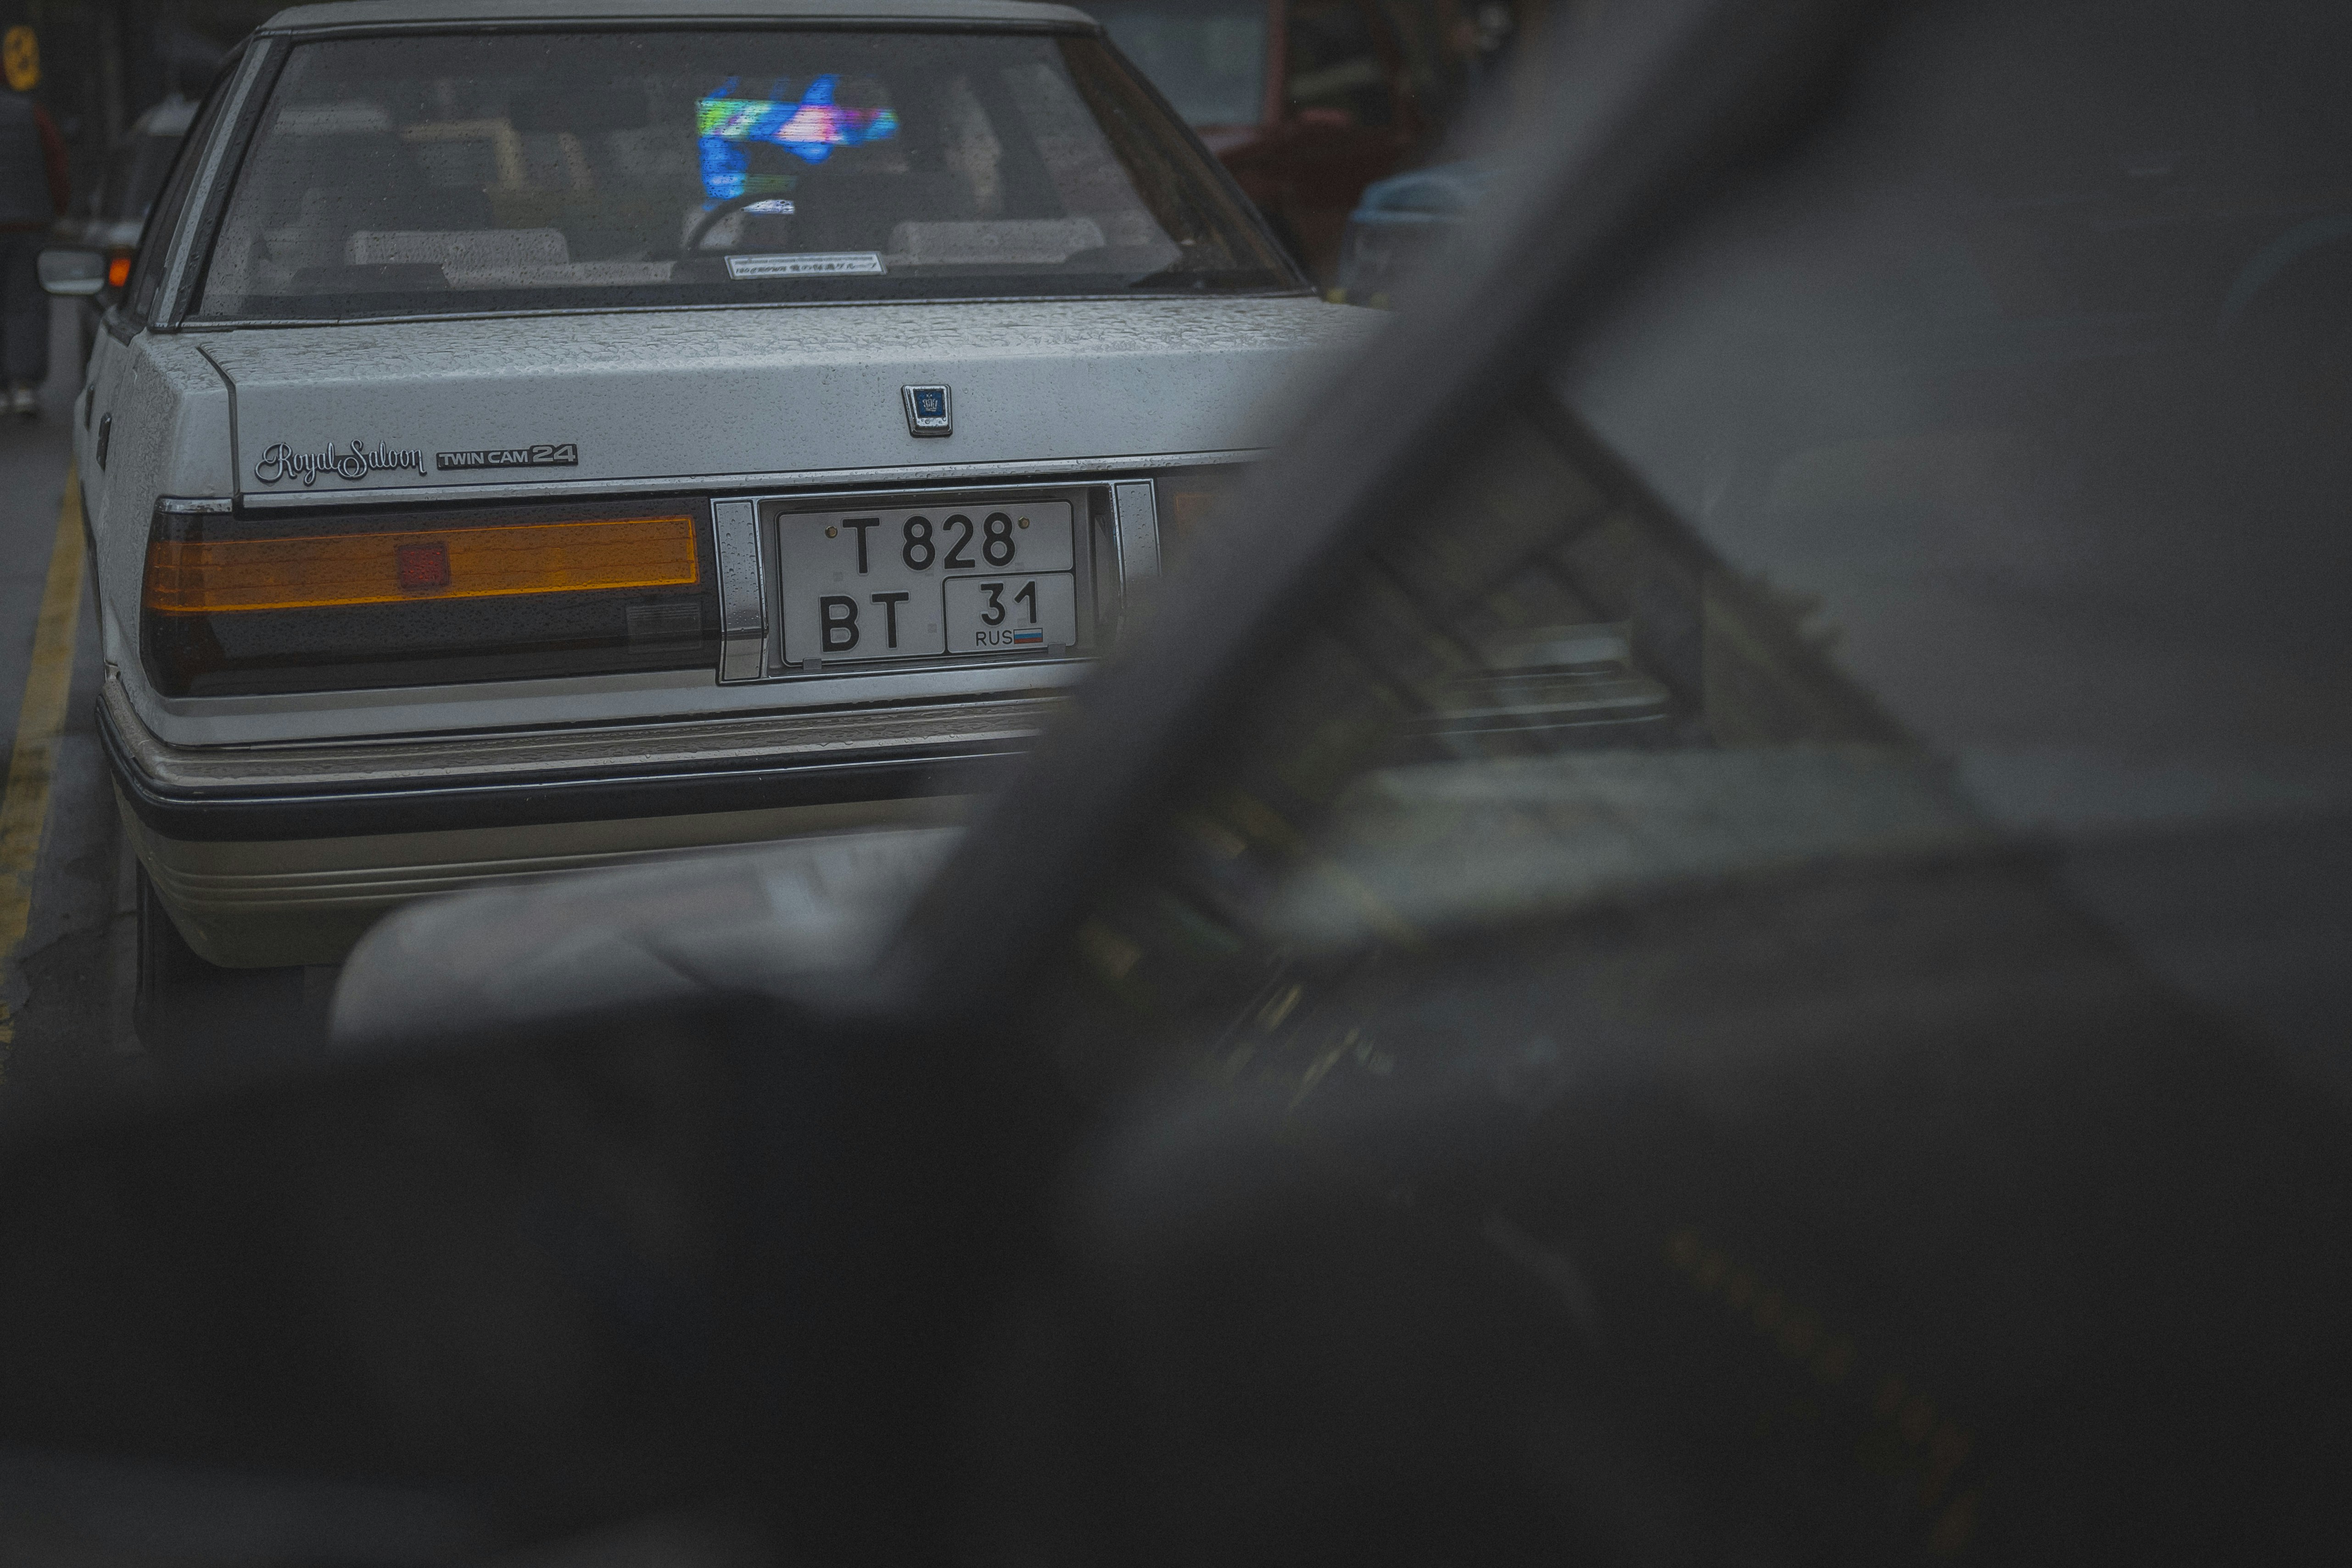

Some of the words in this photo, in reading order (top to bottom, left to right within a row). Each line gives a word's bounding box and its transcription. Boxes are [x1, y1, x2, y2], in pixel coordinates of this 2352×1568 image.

[254, 442, 338, 485] Royal
[337, 439, 427, 478] Saloon
[439, 452, 485, 465] TWIN
[488, 450, 528, 464] CAM
[532, 445, 576, 462] 24
[842, 517, 880, 574] T
[902, 512, 1016, 571] 828
[820, 591, 909, 653] BT
[980, 580, 1037, 626] 31
[976, 629, 1013, 647] RUS
